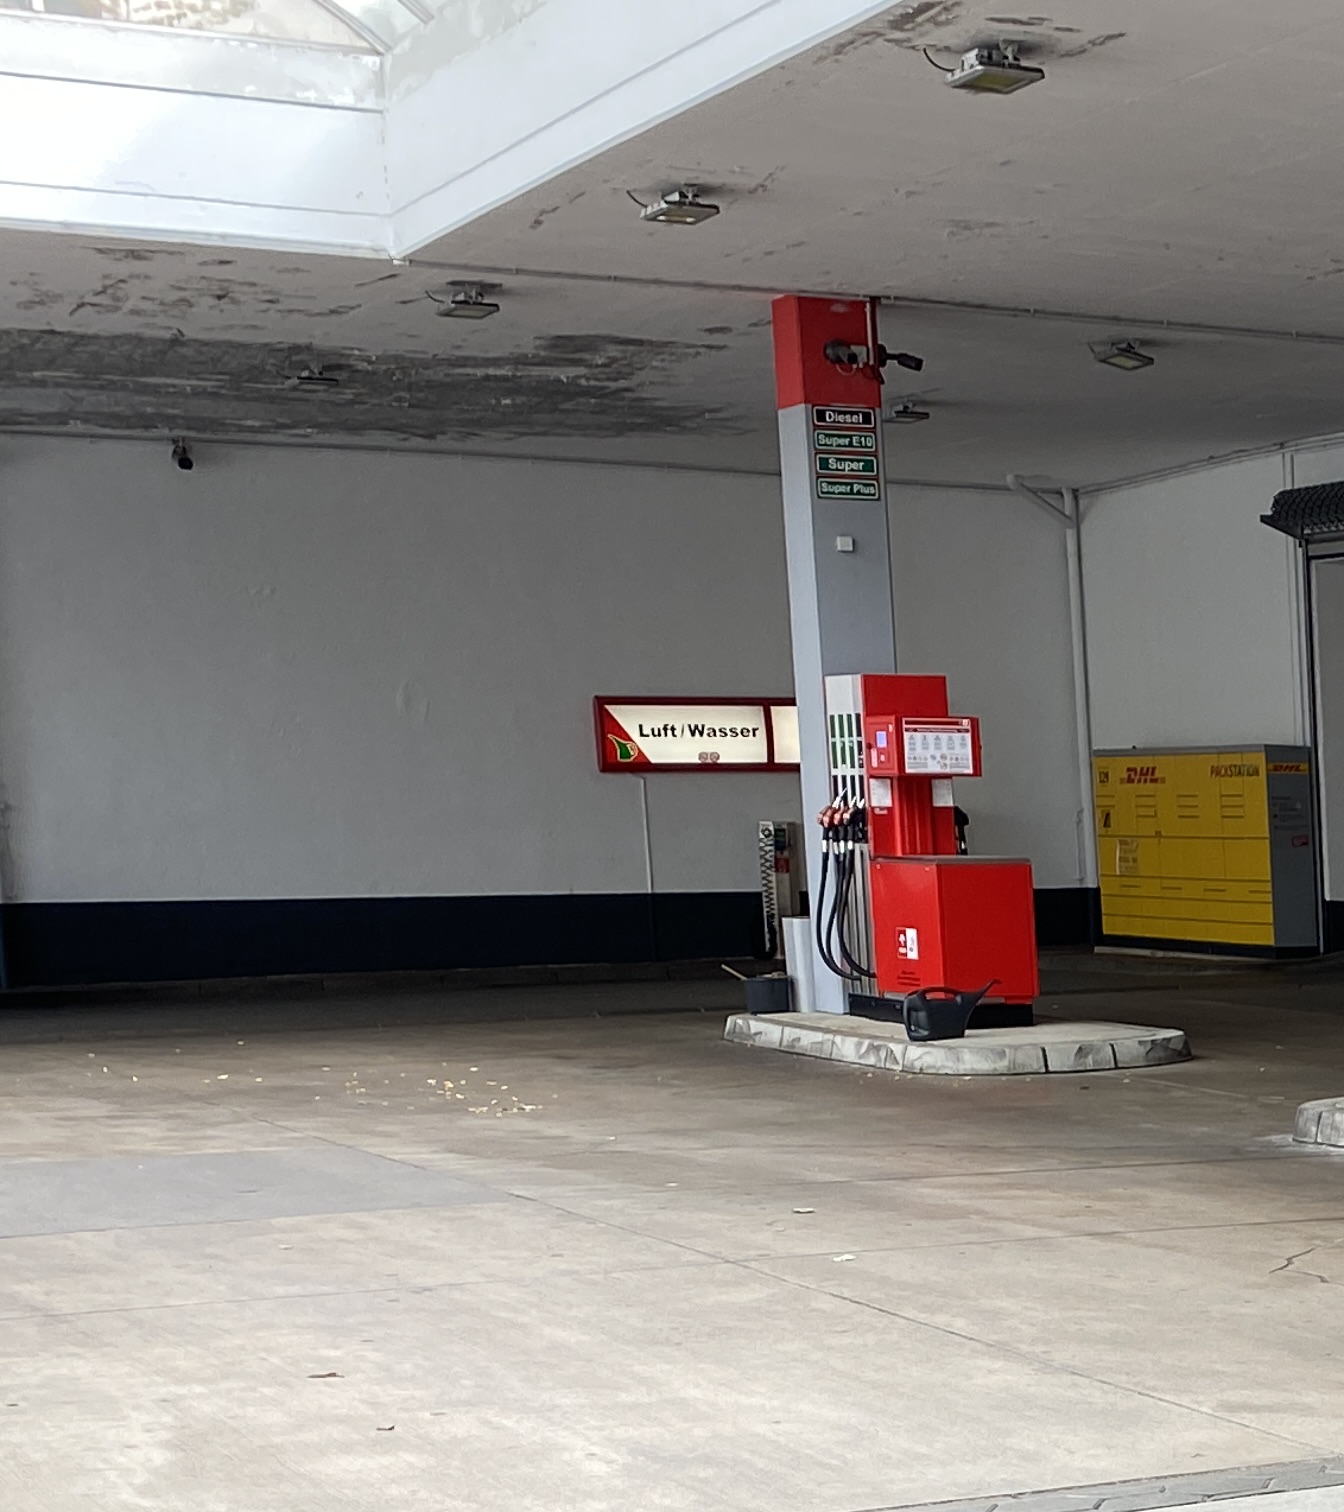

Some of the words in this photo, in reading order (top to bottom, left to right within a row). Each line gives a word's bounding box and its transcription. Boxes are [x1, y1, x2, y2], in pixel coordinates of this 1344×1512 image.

[825, 411, 863, 424] Diesel
[818, 433, 850, 448] Super
[852, 436, 873, 447] E10
[828, 457, 865, 472] Super
[821, 482, 851, 494] Super
[853, 483, 876, 494] Plus
[1126, 766, 1159, 784] DHL
